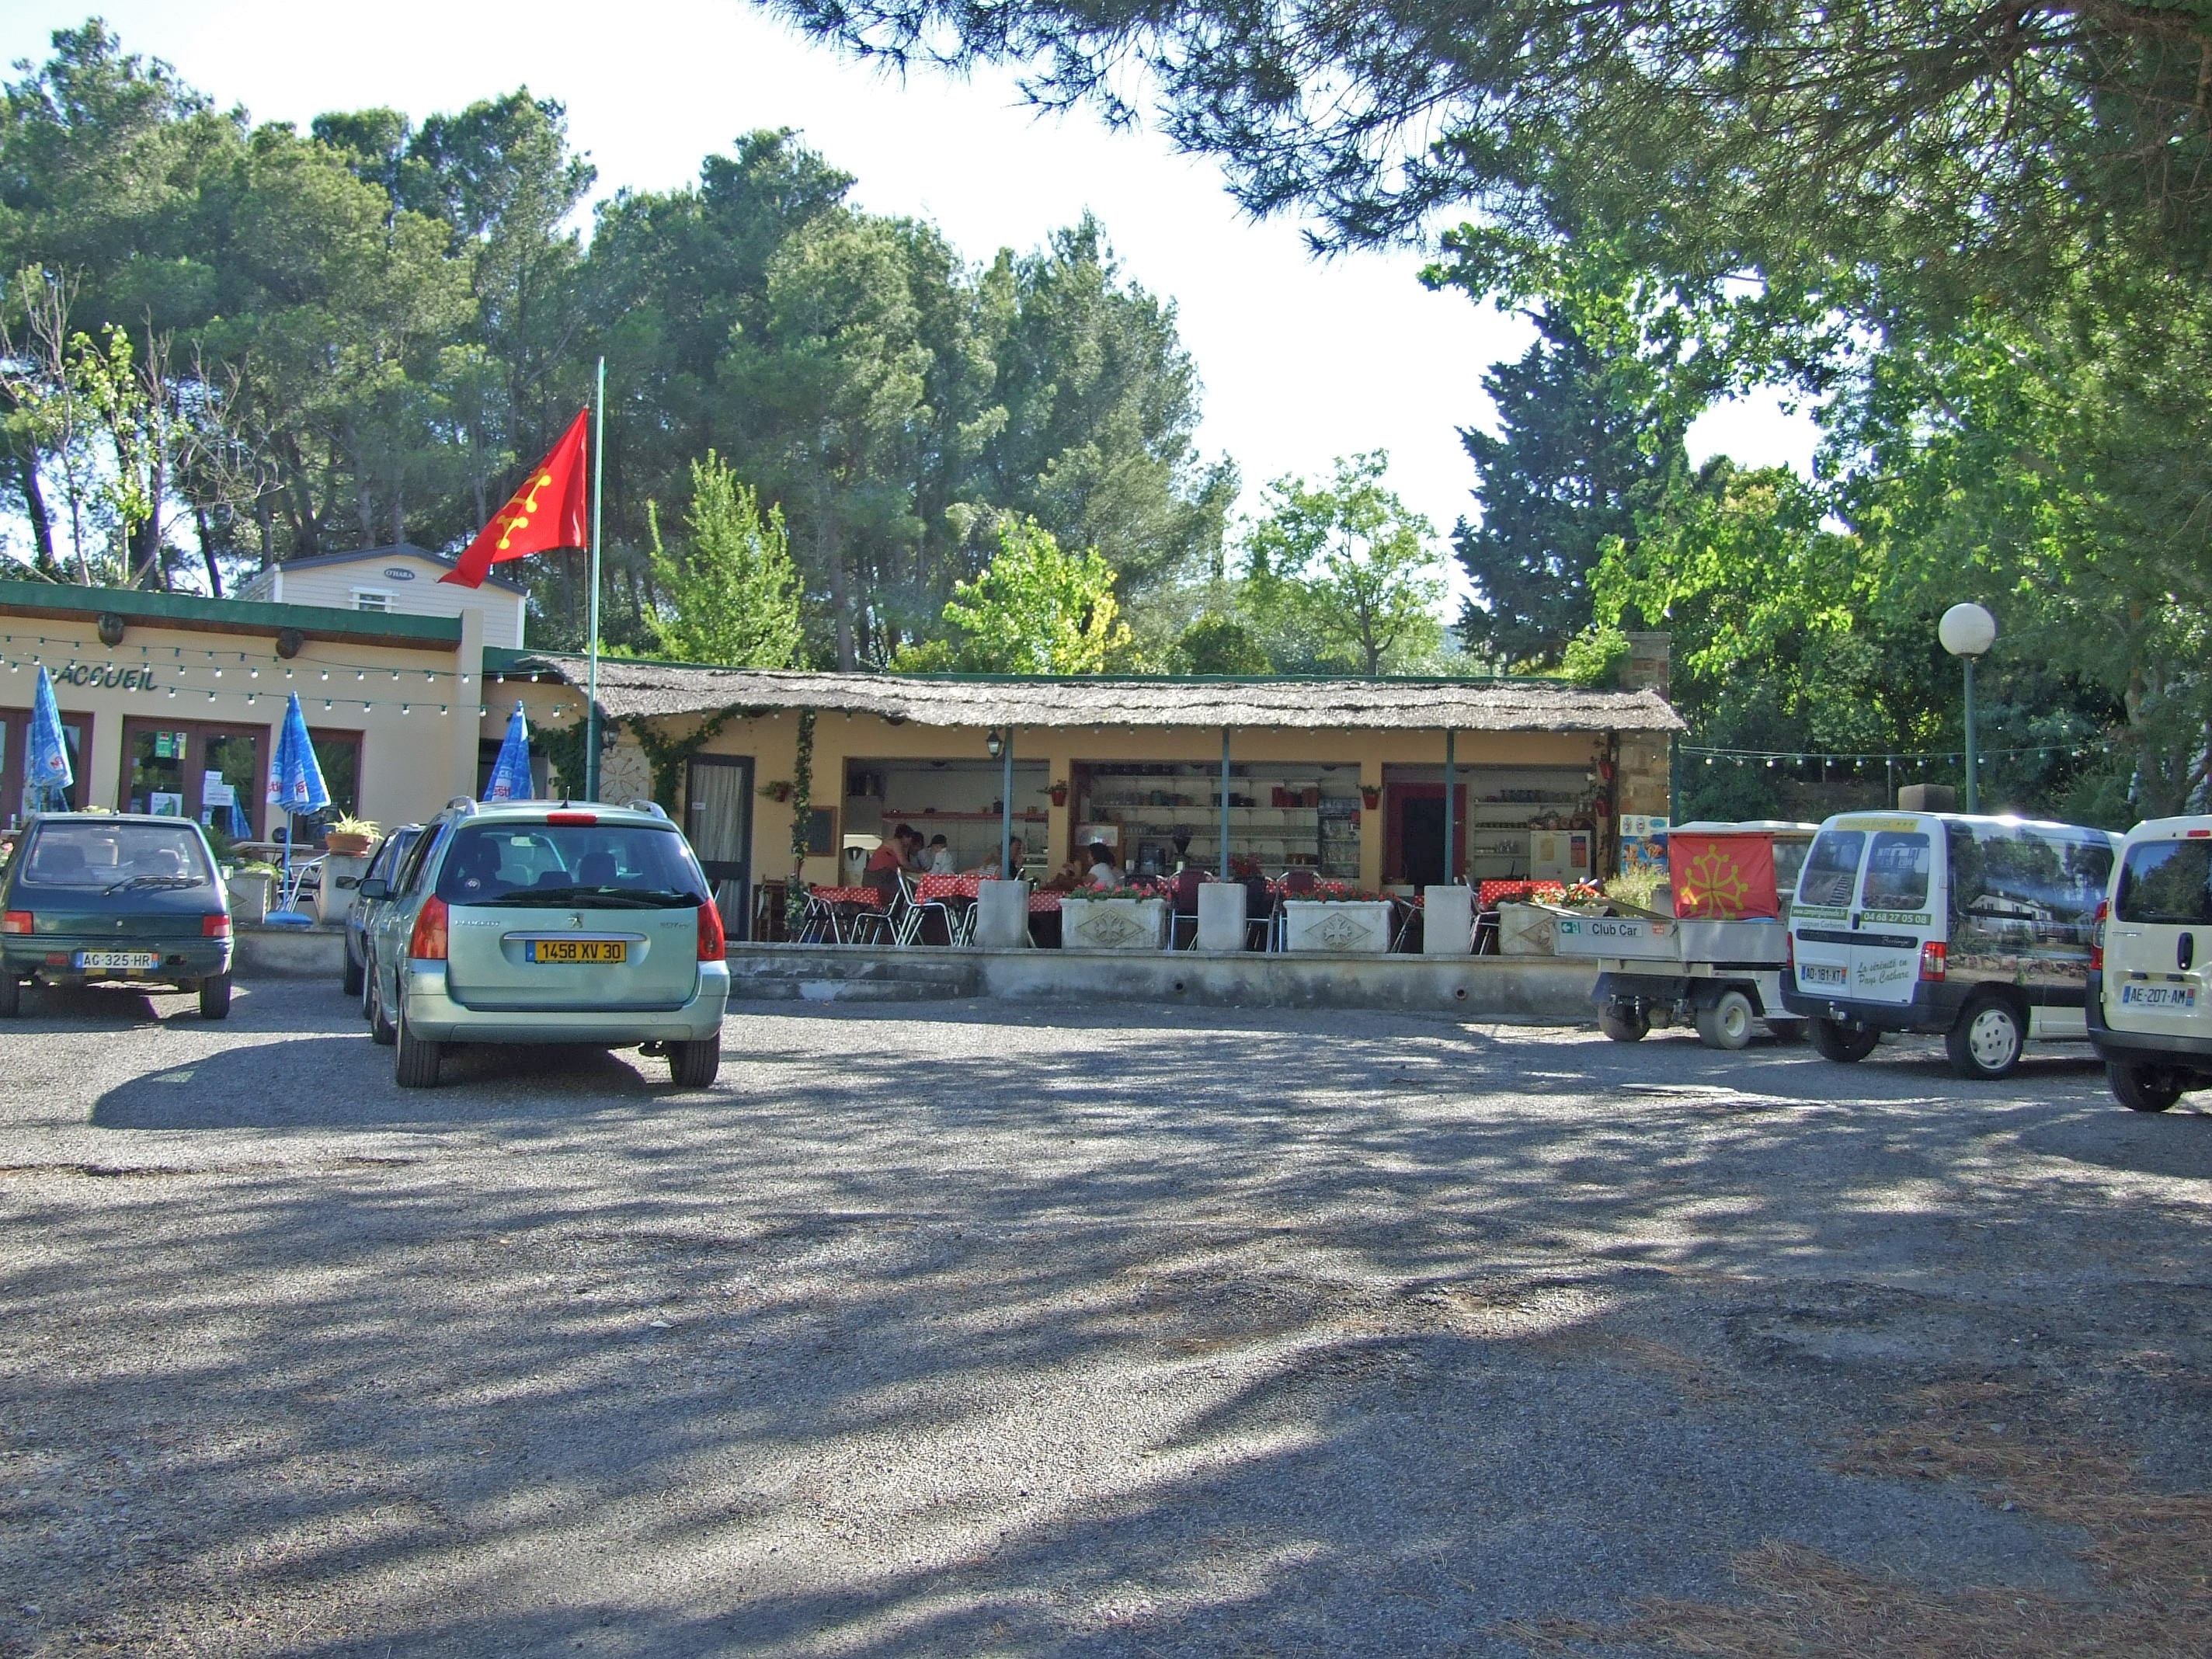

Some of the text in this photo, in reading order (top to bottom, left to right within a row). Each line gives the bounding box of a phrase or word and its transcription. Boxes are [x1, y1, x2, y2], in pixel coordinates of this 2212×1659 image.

[54, 666, 158, 690] ACCUEIL
[1864, 912, 1875, 920] 04
[1902, 914, 1914, 923] 05
[1915, 915, 1927, 923] 08
[1592, 923, 1637, 936] Club Car
[542, 944, 621, 959] 1458 XV 30
[84, 954, 150, 966] AG-325-HR
[1856, 962, 1867, 973] La
[1858, 969, 1910, 986] Pays Cathare
[2130, 988, 2186, 1004] AE-207-AM
